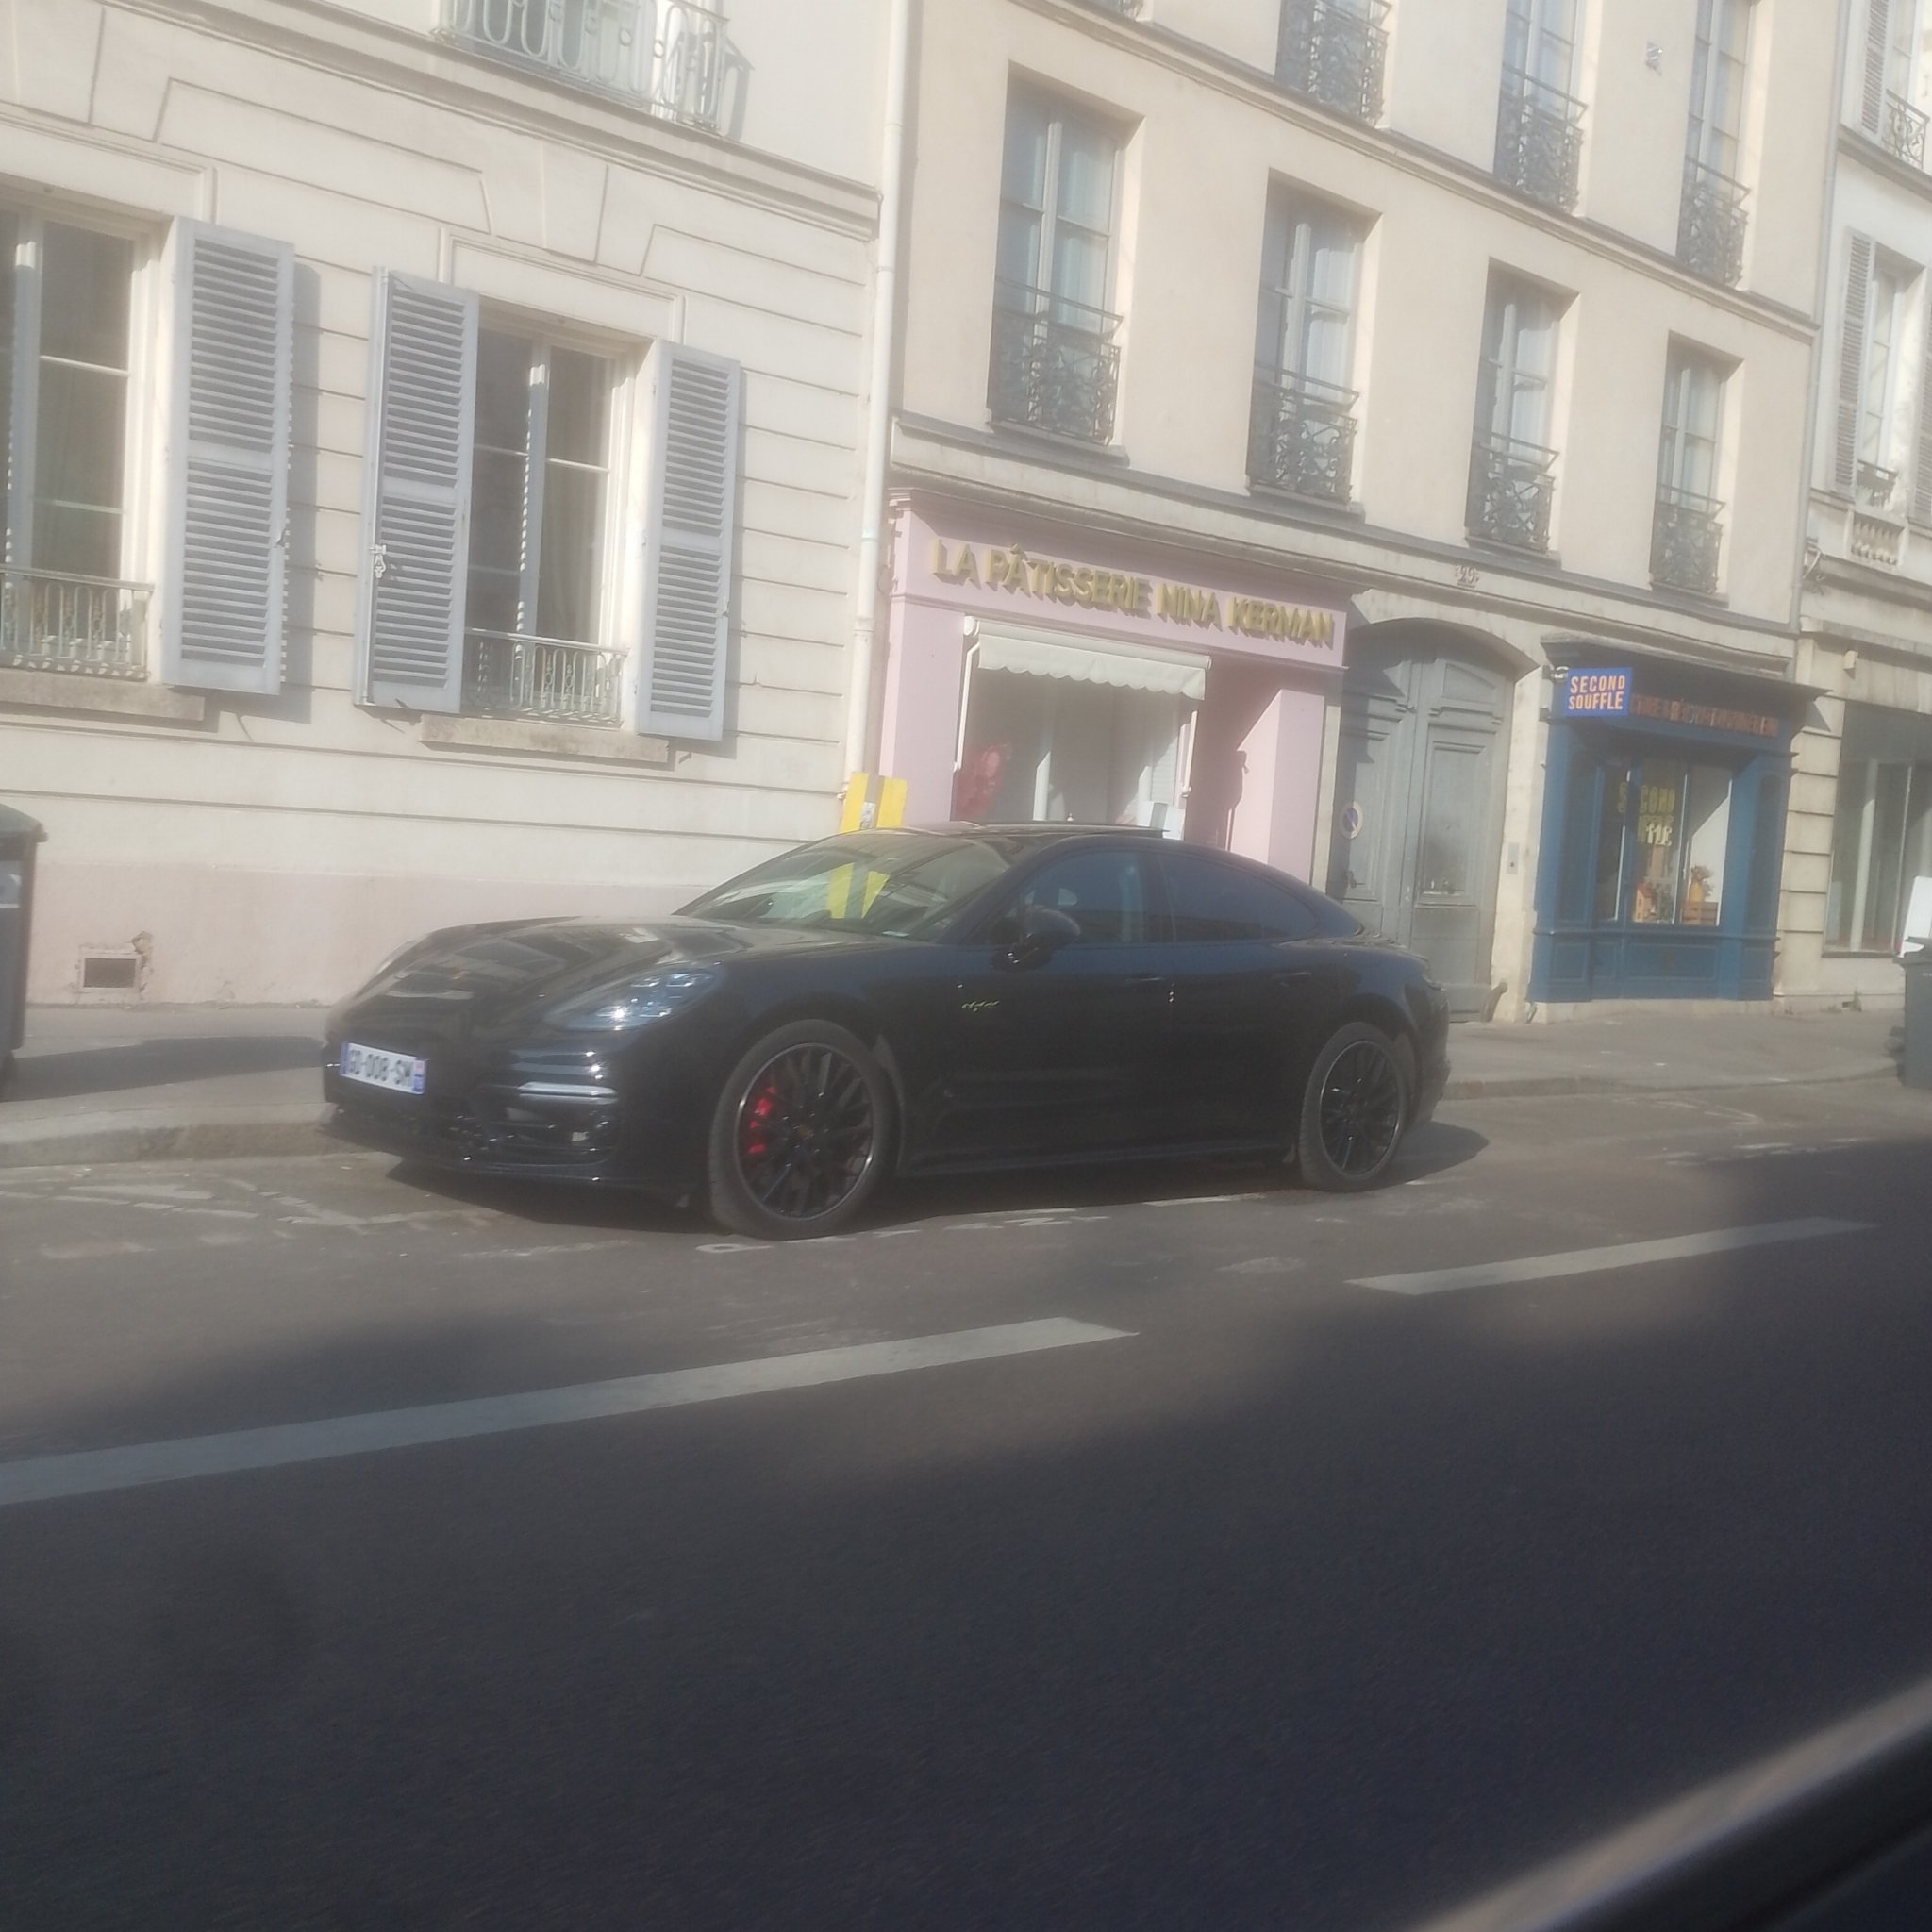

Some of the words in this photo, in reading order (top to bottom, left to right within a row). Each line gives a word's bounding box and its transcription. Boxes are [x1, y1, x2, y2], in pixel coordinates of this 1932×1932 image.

[932, 538, 980, 584] LA
[984, 542, 1150, 611] PÂTISSERIE
[1157, 582, 1220, 625] NINA
[1228, 595, 1334, 644] KERMAN
[1570, 675, 1625, 694] SECOND
[1568, 691, 1624, 710] SOUFFLE
